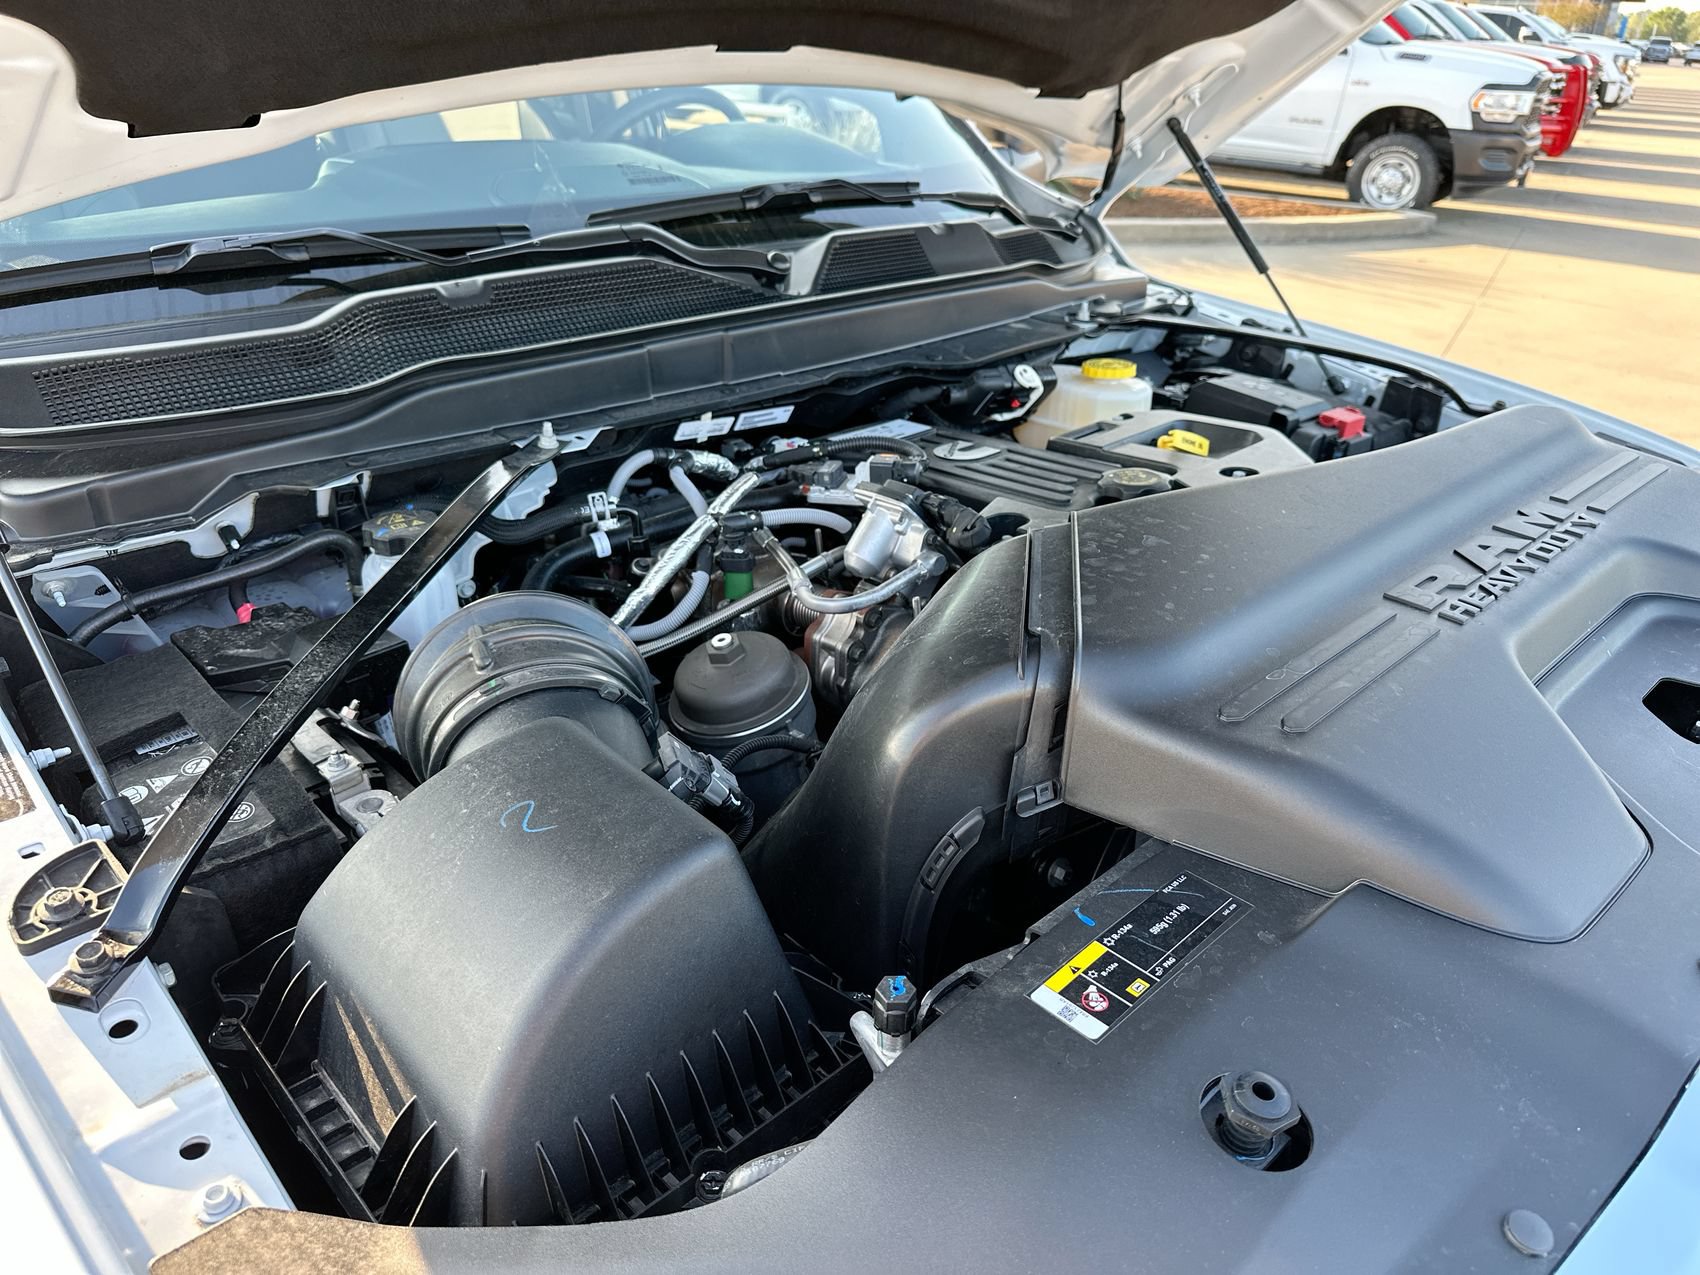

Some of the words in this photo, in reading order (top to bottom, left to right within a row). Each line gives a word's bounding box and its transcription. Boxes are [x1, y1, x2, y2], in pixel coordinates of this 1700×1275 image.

[1382, 501, 1577, 613] RAM
[1149, 920, 1169, 935] 595g
[1163, 957, 1177, 968] PAG
